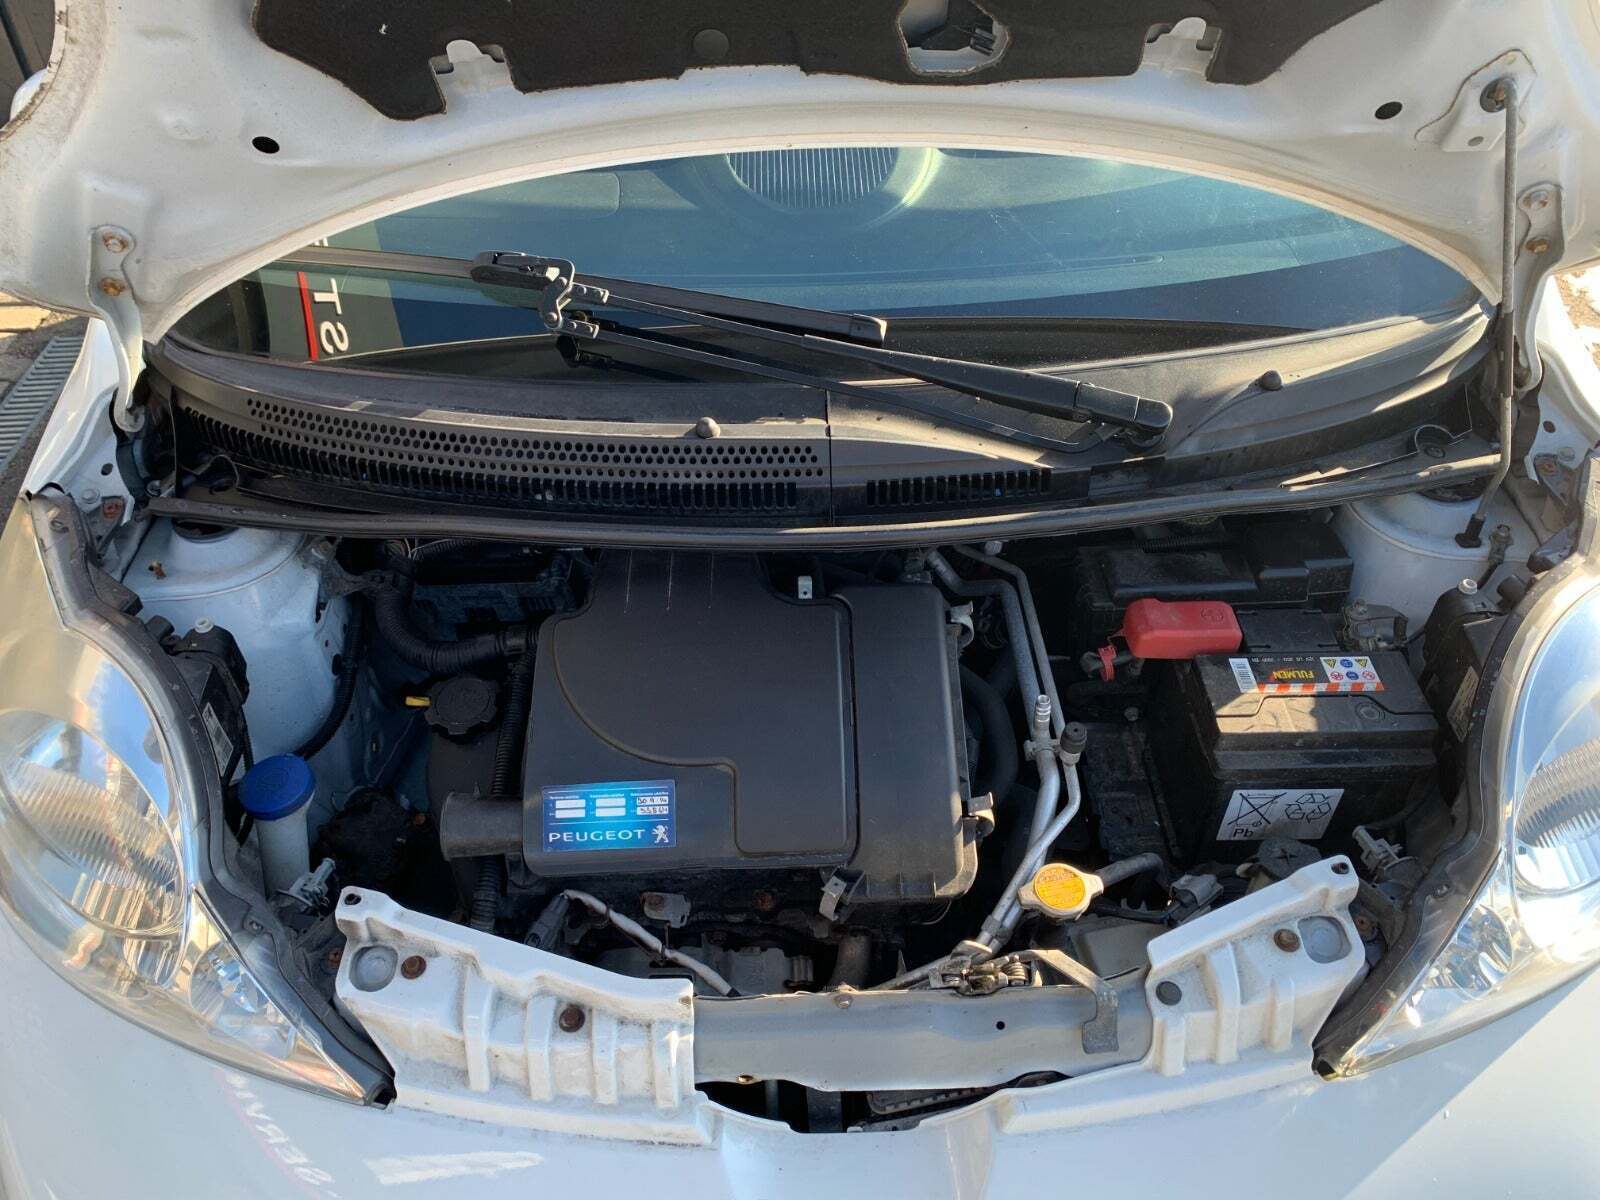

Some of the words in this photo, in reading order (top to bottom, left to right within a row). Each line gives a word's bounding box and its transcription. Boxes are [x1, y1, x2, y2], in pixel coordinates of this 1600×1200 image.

[1273, 670, 1315, 680] FULMEN
[548, 829, 646, 843] PEUGEOT
[1233, 828, 1254, 838] Pb
